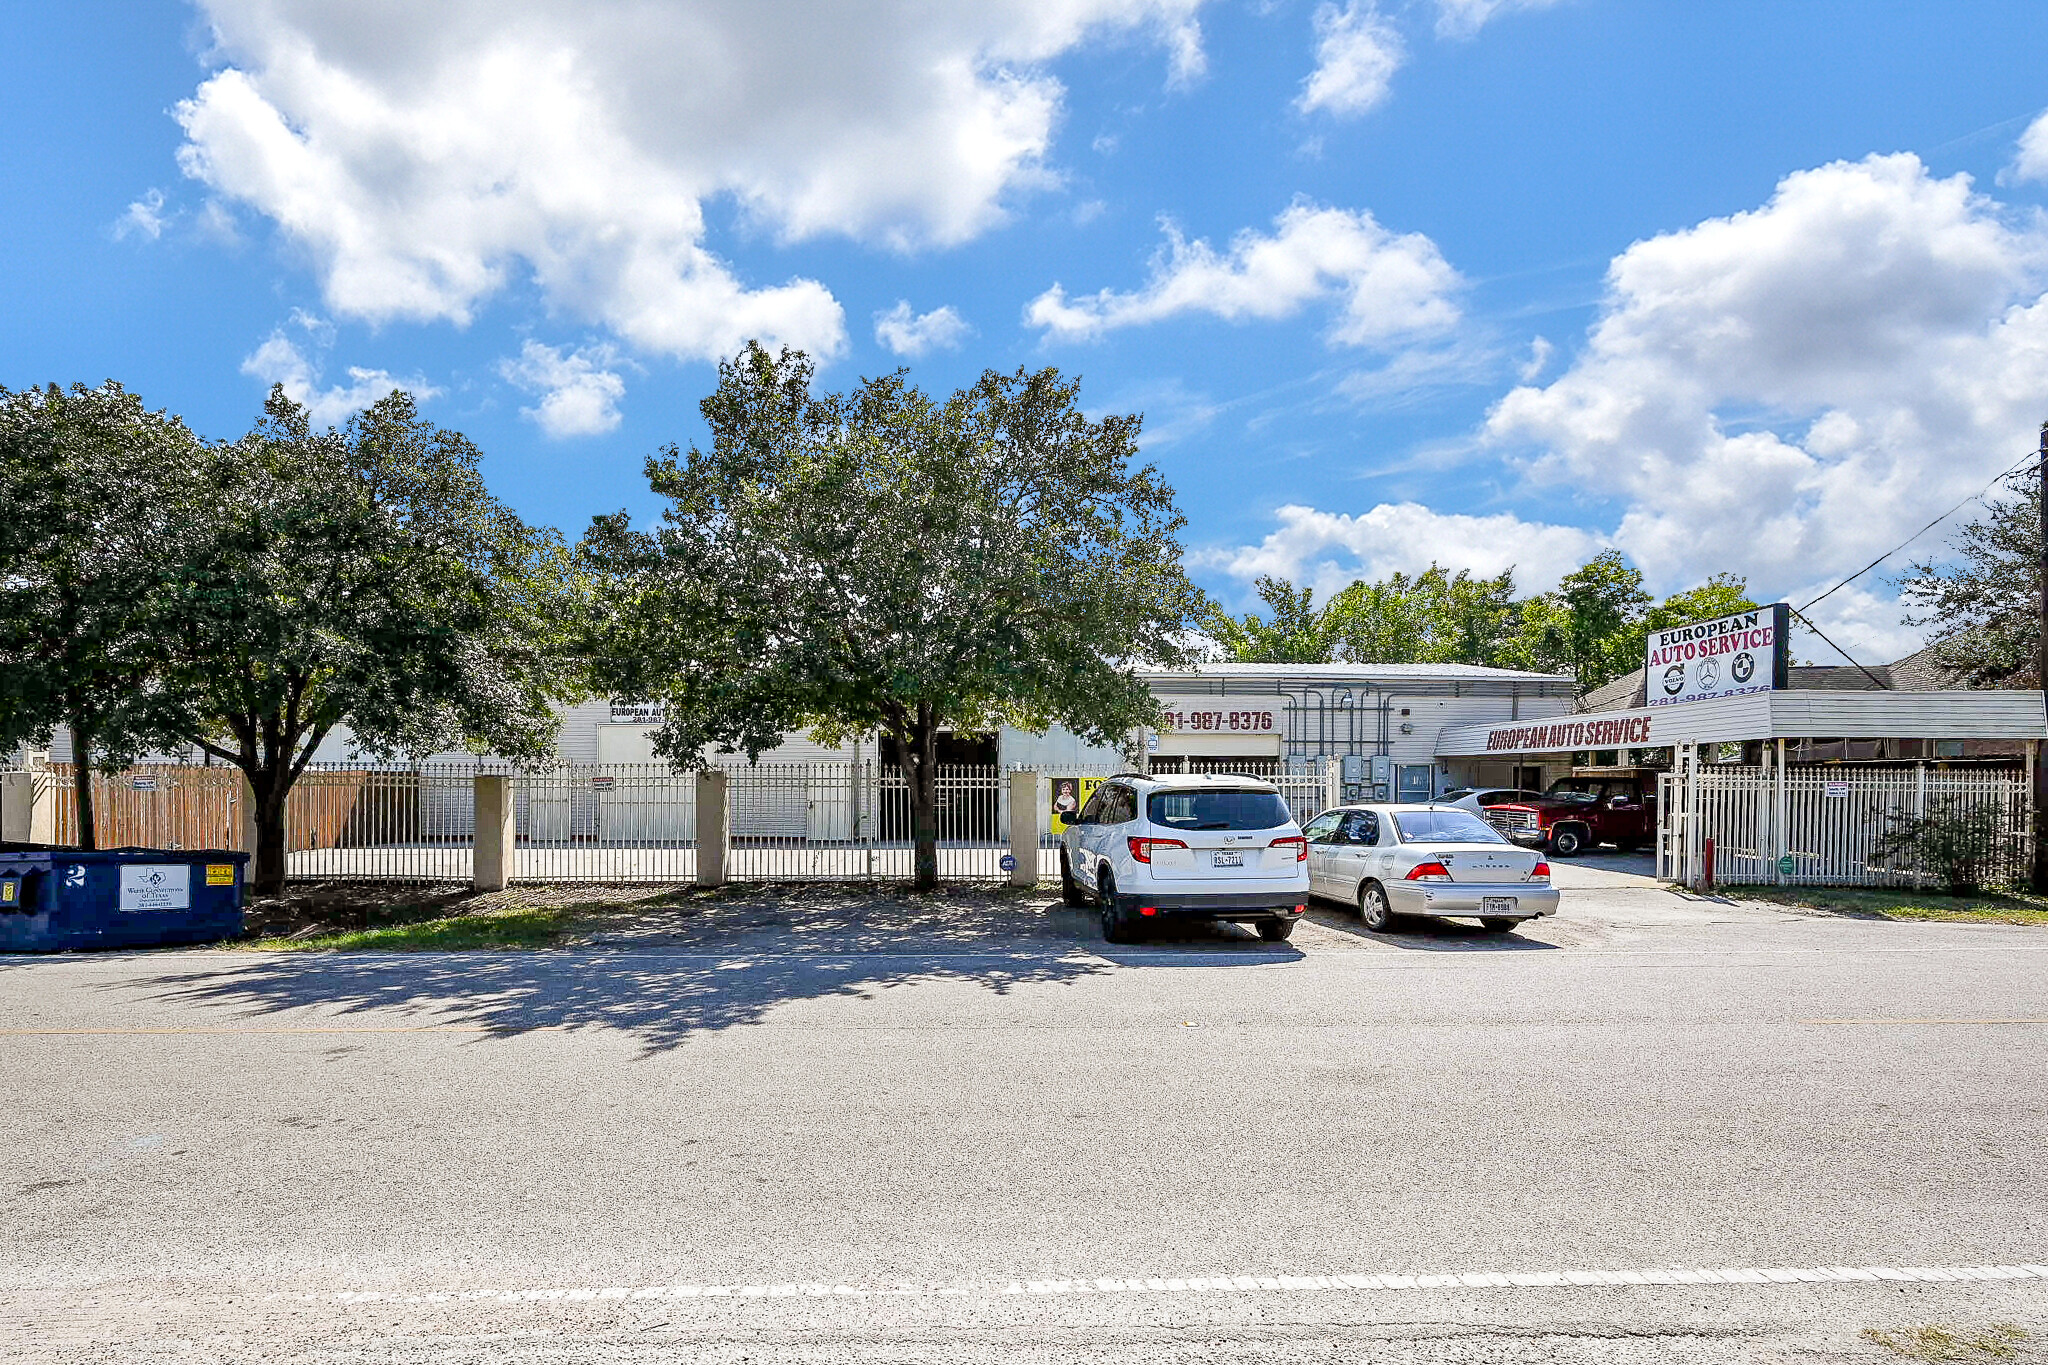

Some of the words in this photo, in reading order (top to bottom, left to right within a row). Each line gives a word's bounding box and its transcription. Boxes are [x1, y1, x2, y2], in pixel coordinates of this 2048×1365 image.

[1660, 612, 1760, 646] EUROPEAN
[1649, 642, 1695, 667] AUTO
[1698, 626, 1773, 658] SERVICE
[612, 707, 649, 717] EUROPEAN
[1487, 726, 1548, 751] EUROPEAN
[1547, 723, 1585, 748] AUTO
[1585, 716, 1652, 745] SERVICE
